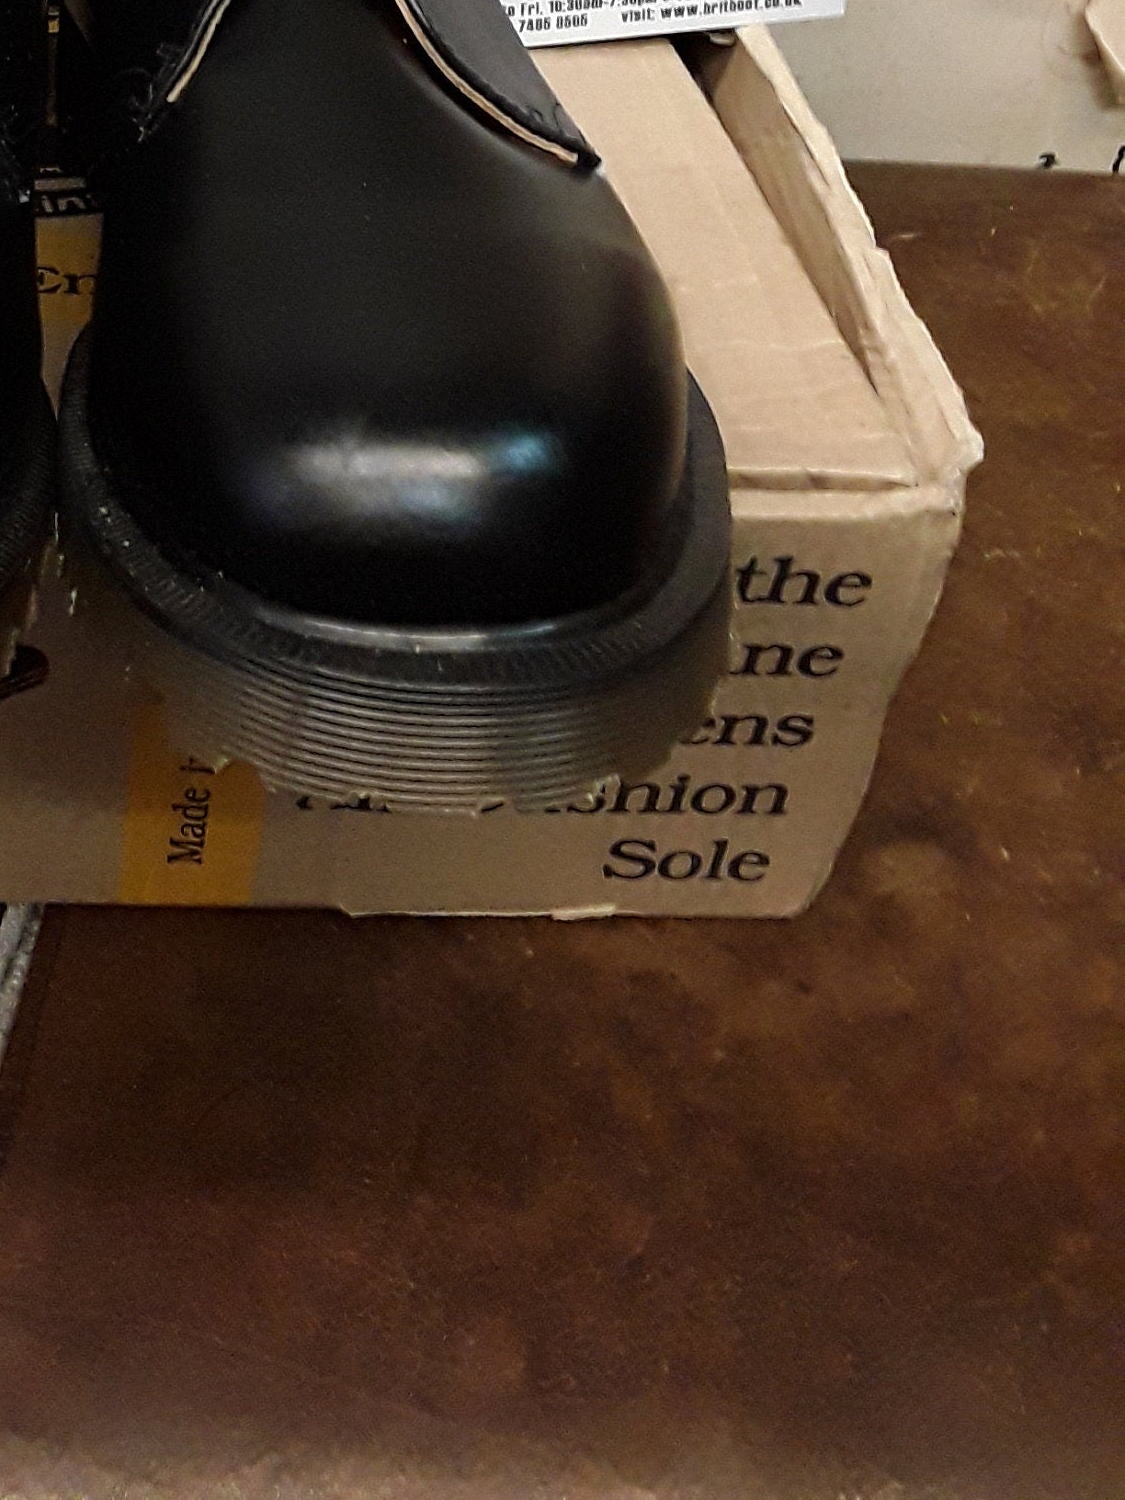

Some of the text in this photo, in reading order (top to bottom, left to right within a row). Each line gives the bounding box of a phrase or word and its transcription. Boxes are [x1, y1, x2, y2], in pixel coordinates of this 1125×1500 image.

[736, 556, 873, 608] the
[730, 642, 845, 680] ne
[167, 788, 210, 865] Made
[602, 838, 771, 882] Sole
